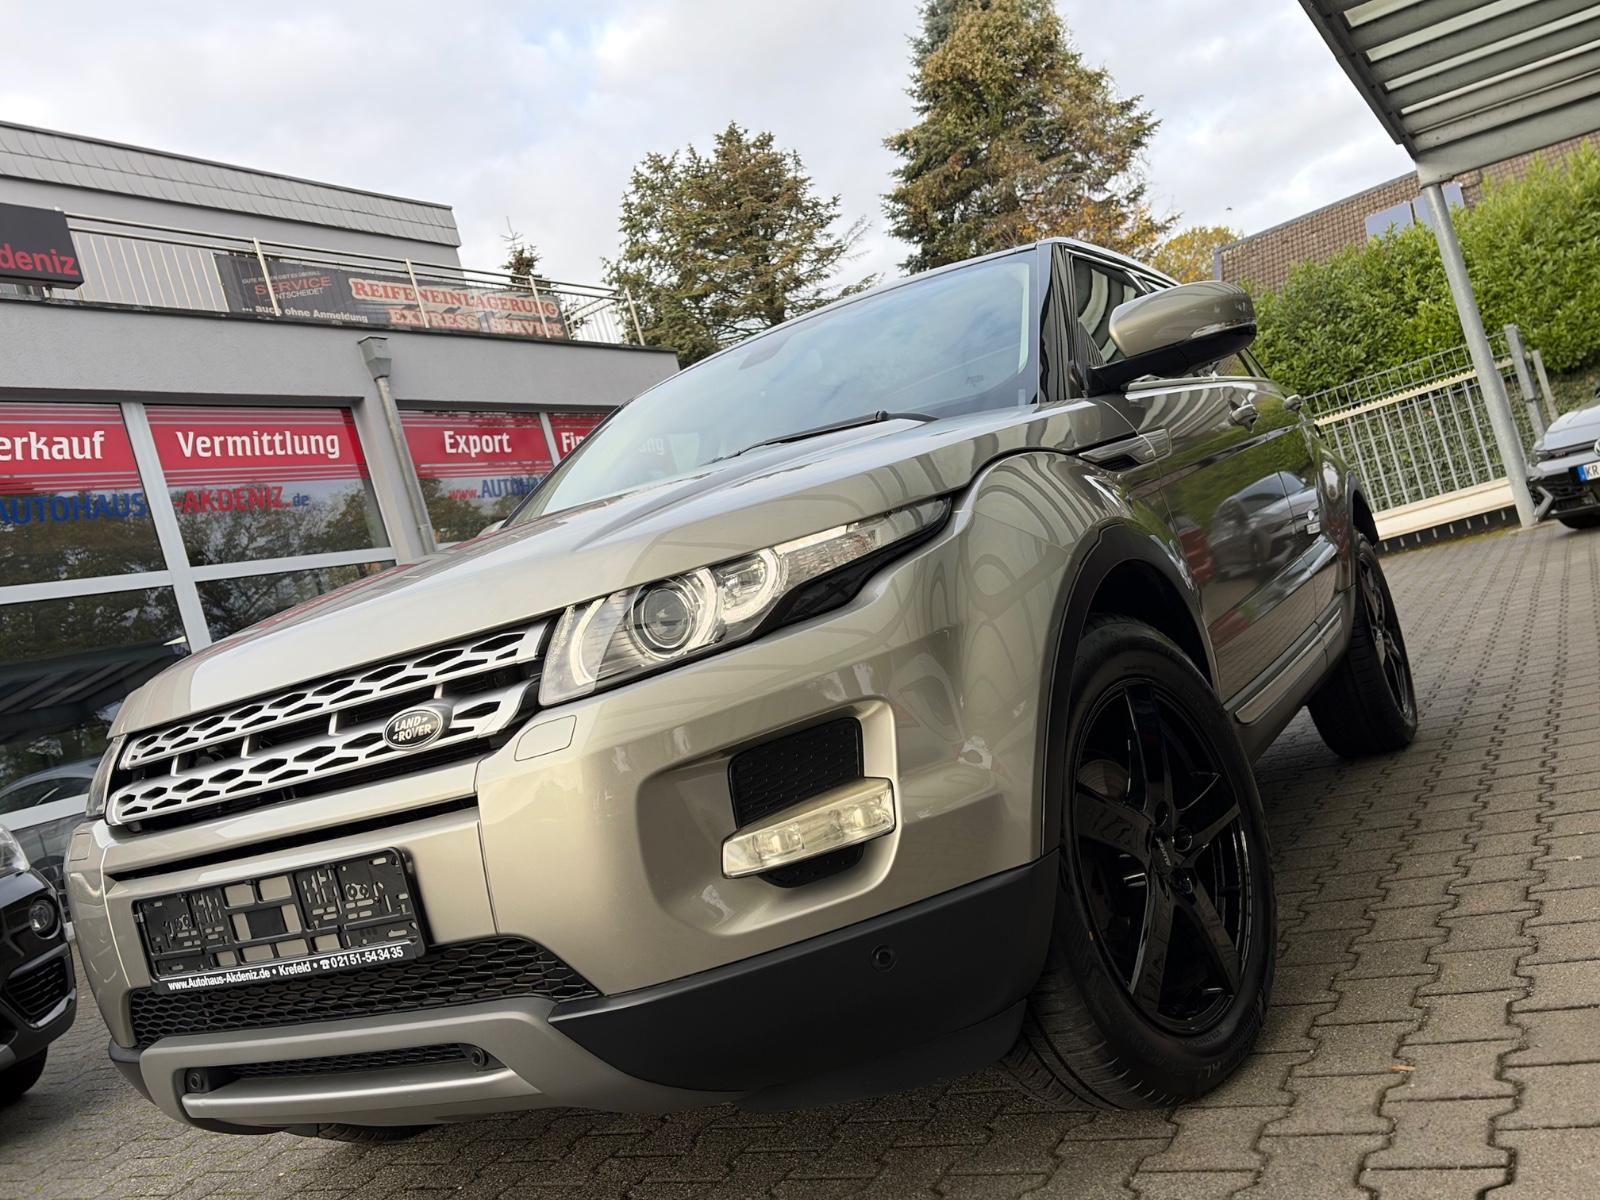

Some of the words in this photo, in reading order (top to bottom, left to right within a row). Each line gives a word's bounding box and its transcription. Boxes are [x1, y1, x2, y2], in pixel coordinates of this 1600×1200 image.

[0, 243, 80, 275] deniz
[254, 276, 333, 296] SERVICE
[271, 287, 324, 300] NTSCHEIDET
[284, 307, 311, 317] ohne
[313, 309, 369, 323] Anmeldung
[175, 430, 341, 459] Vermittlung
[443, 430, 513, 457] Export
[394, 715, 422, 732] LAND
[398, 723, 432, 742] ROVER
[168, 967, 271, 991] www.Autohaus-Akdeniz.de
[278, 959, 312, 976] Krefeld
